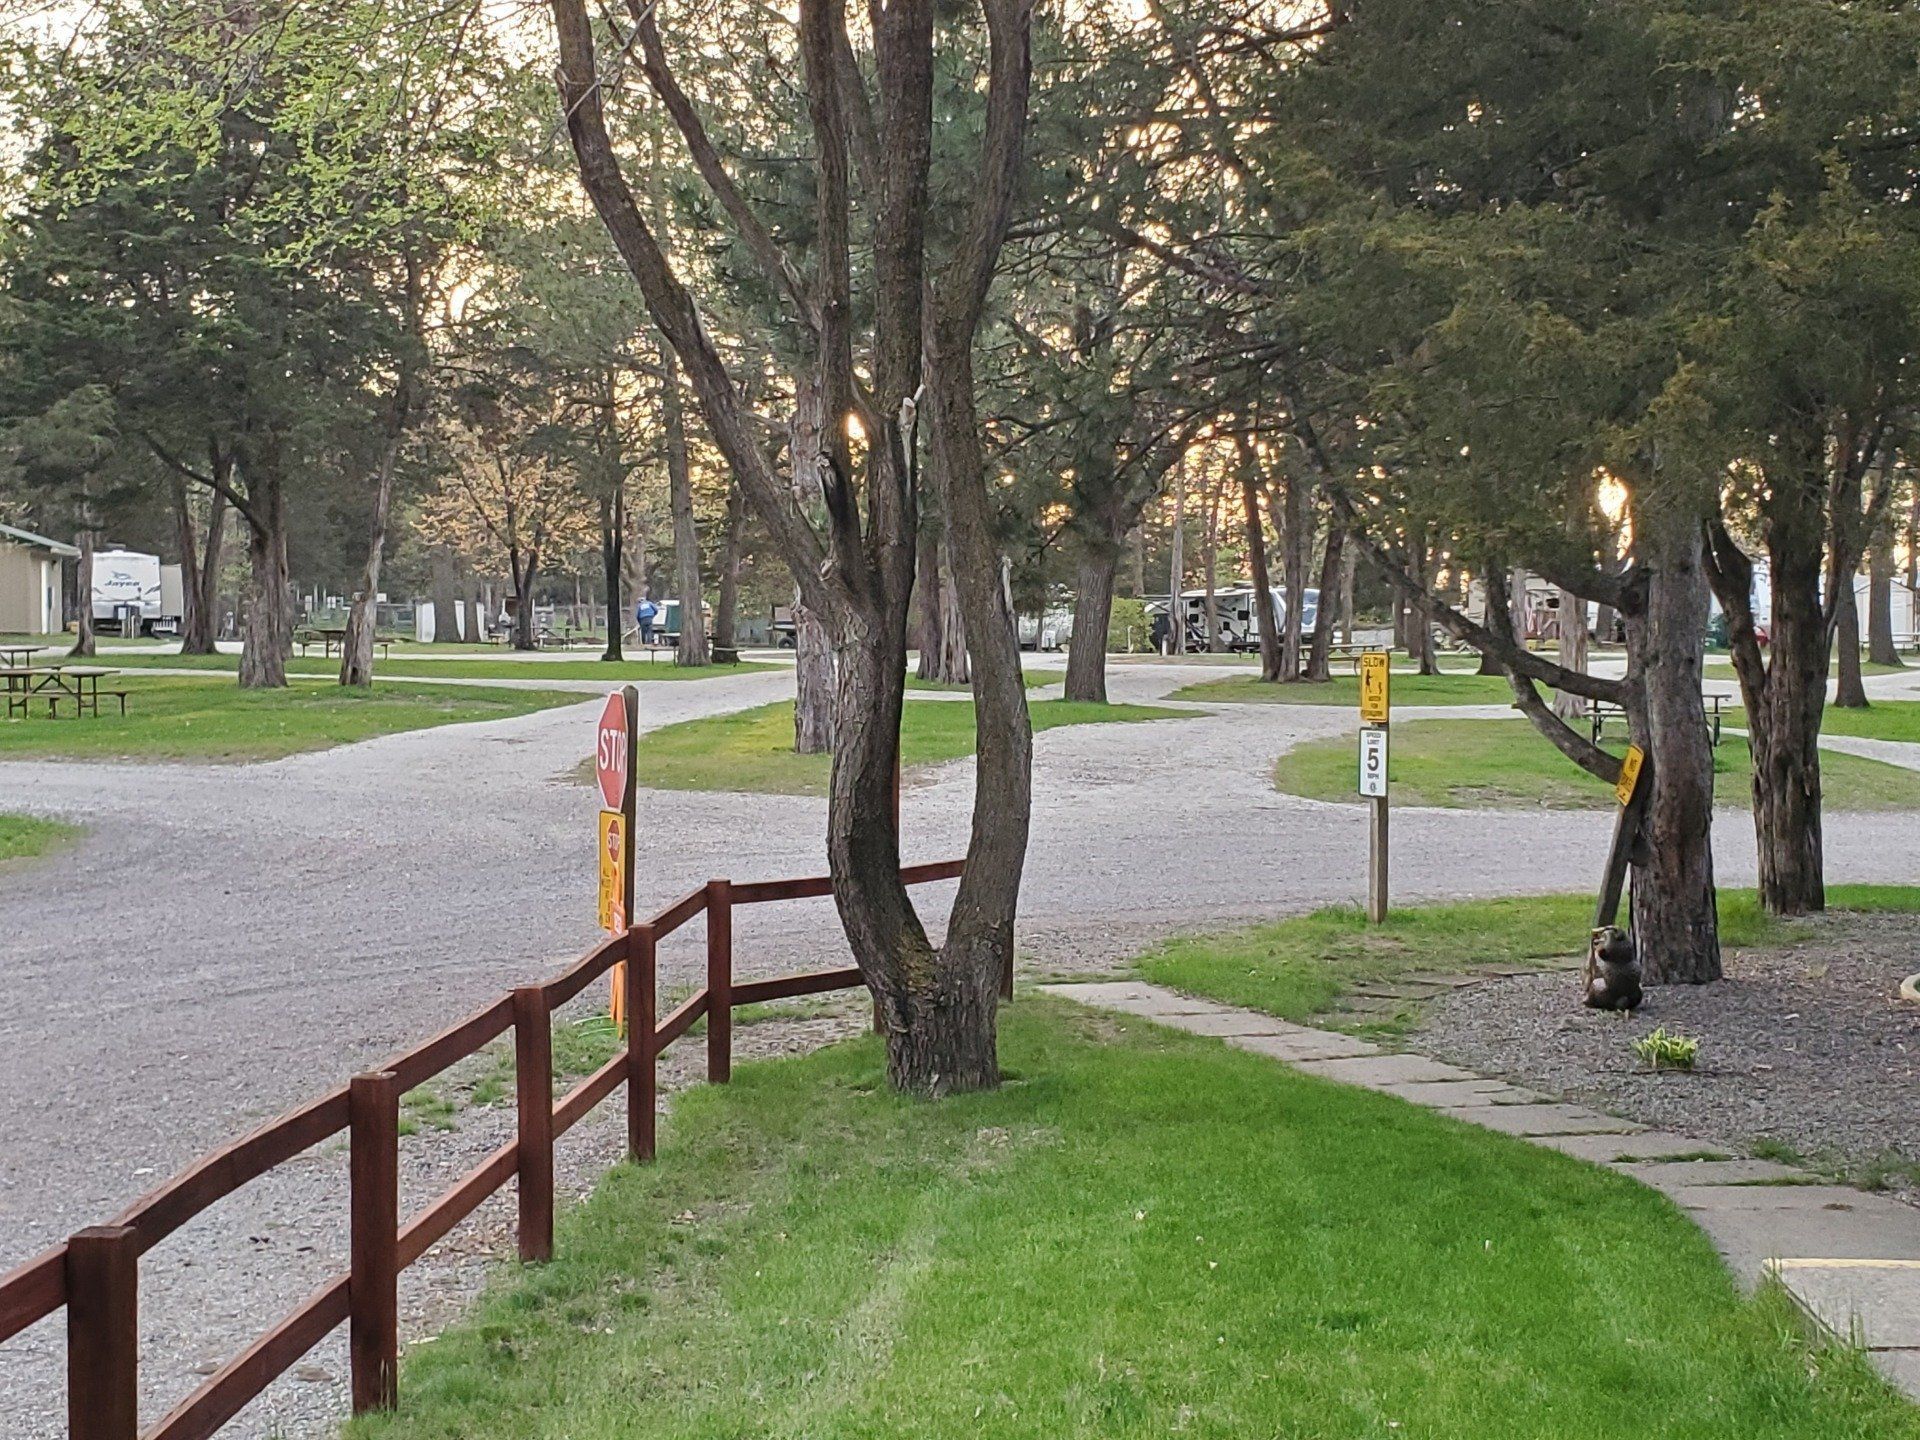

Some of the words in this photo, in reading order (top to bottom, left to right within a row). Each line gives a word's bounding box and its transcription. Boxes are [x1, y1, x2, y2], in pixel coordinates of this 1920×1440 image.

[1363, 656, 1385, 667] SLOW
[600, 728, 627, 773] STOP
[1367, 747, 1379, 771] 5
